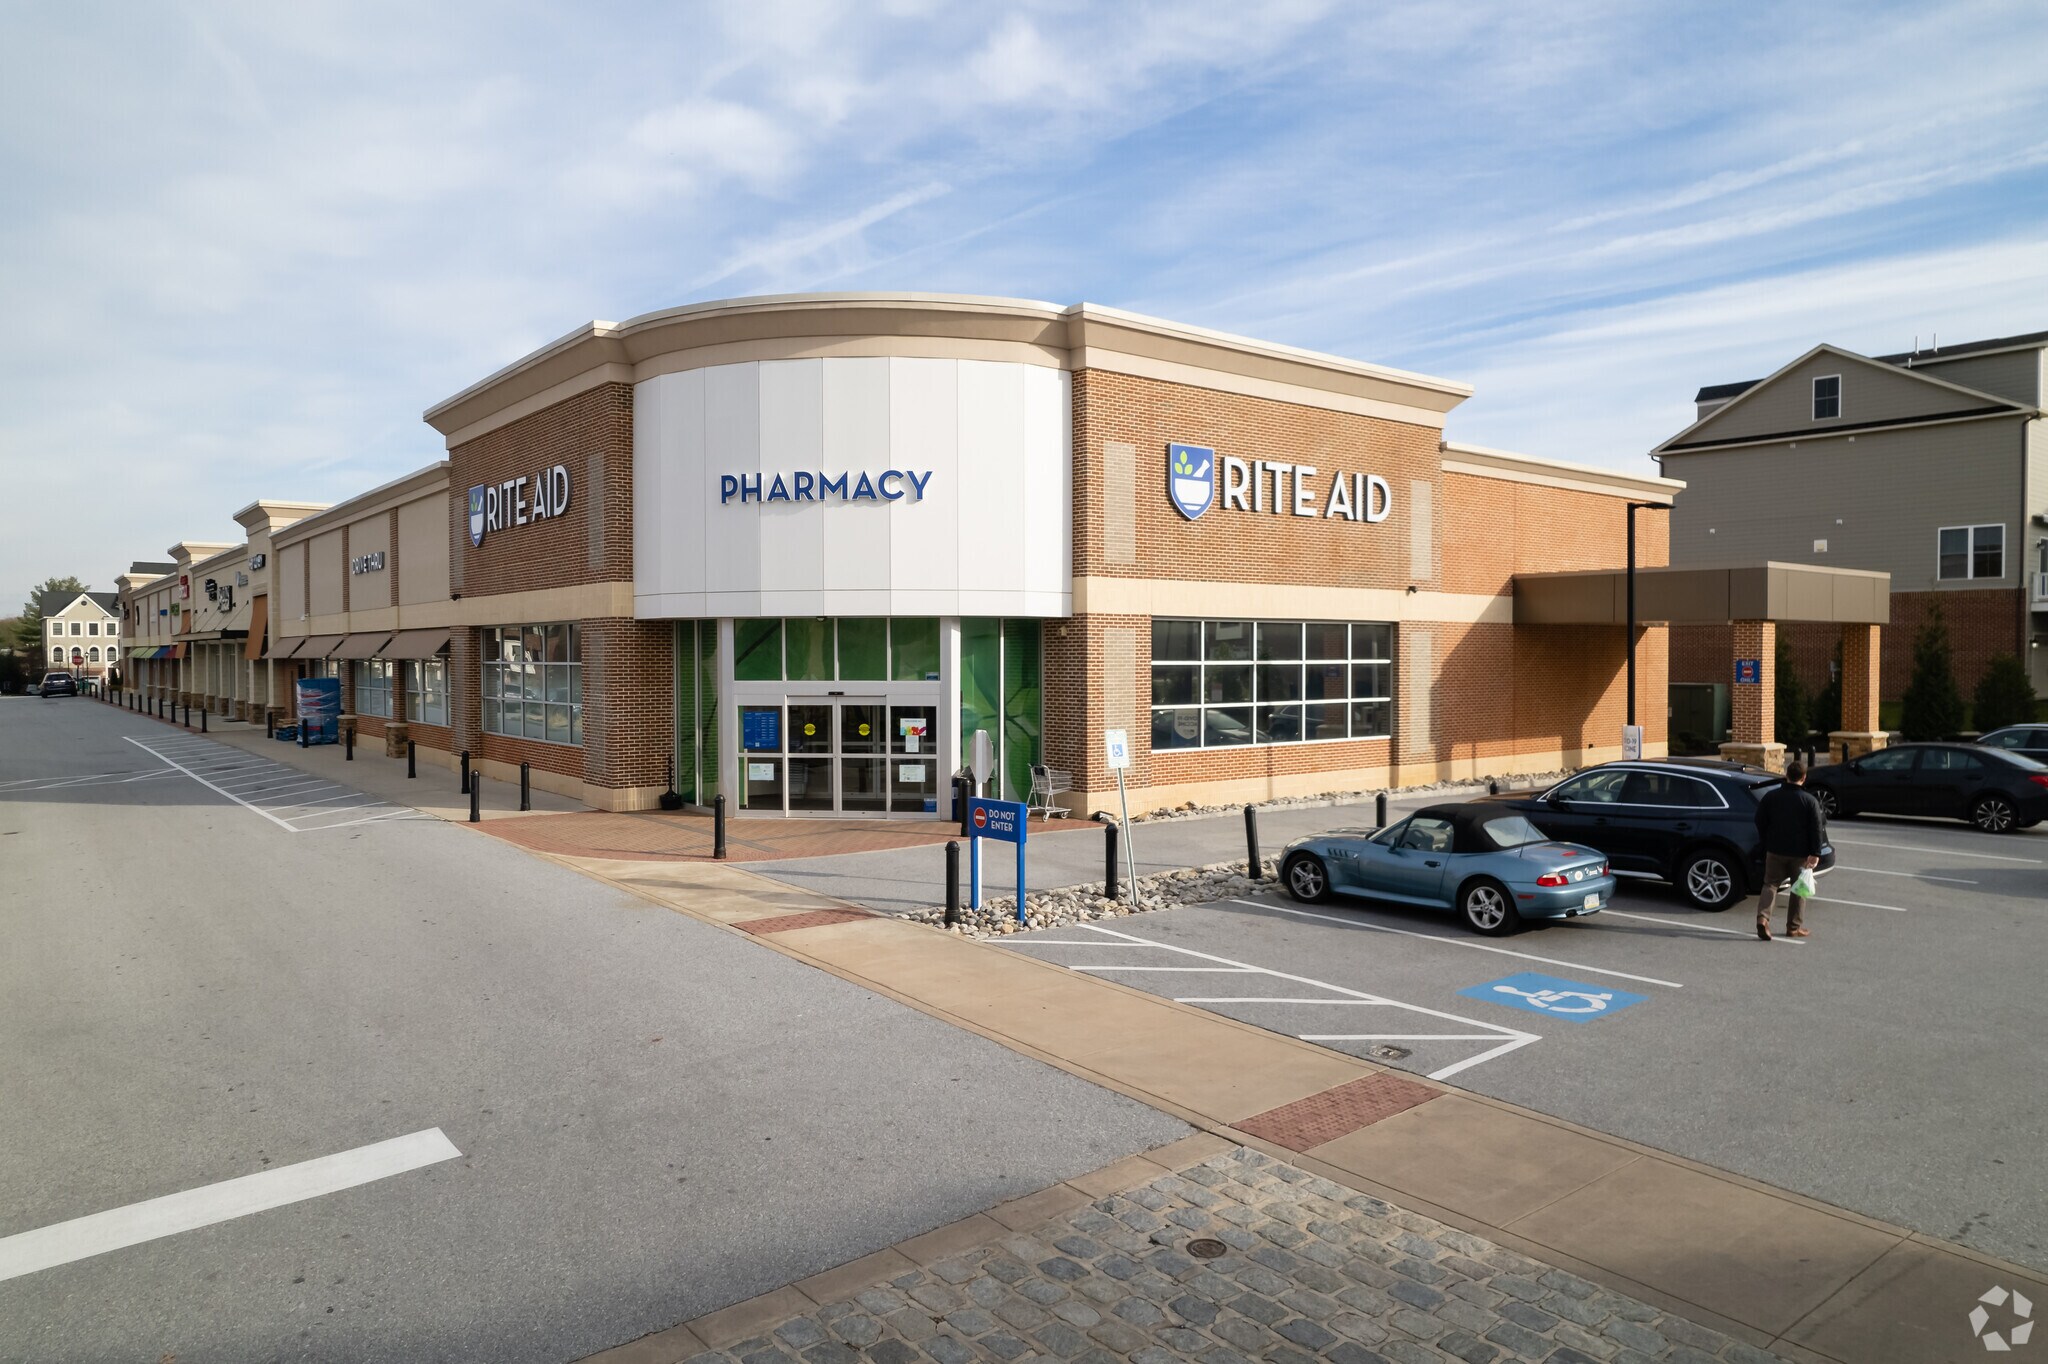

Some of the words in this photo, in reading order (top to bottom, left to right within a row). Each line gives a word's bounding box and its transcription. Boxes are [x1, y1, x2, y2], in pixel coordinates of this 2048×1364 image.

[486, 476, 527, 532] RITE
[530, 465, 571, 522] AID
[720, 469, 934, 505] PHARMACY
[1221, 456, 1317, 517] RITE
[1324, 470, 1391, 523] AID
[989, 809, 999, 818] DO
[1000, 811, 1015, 821] NOT
[991, 820, 1013, 832] ENTER
